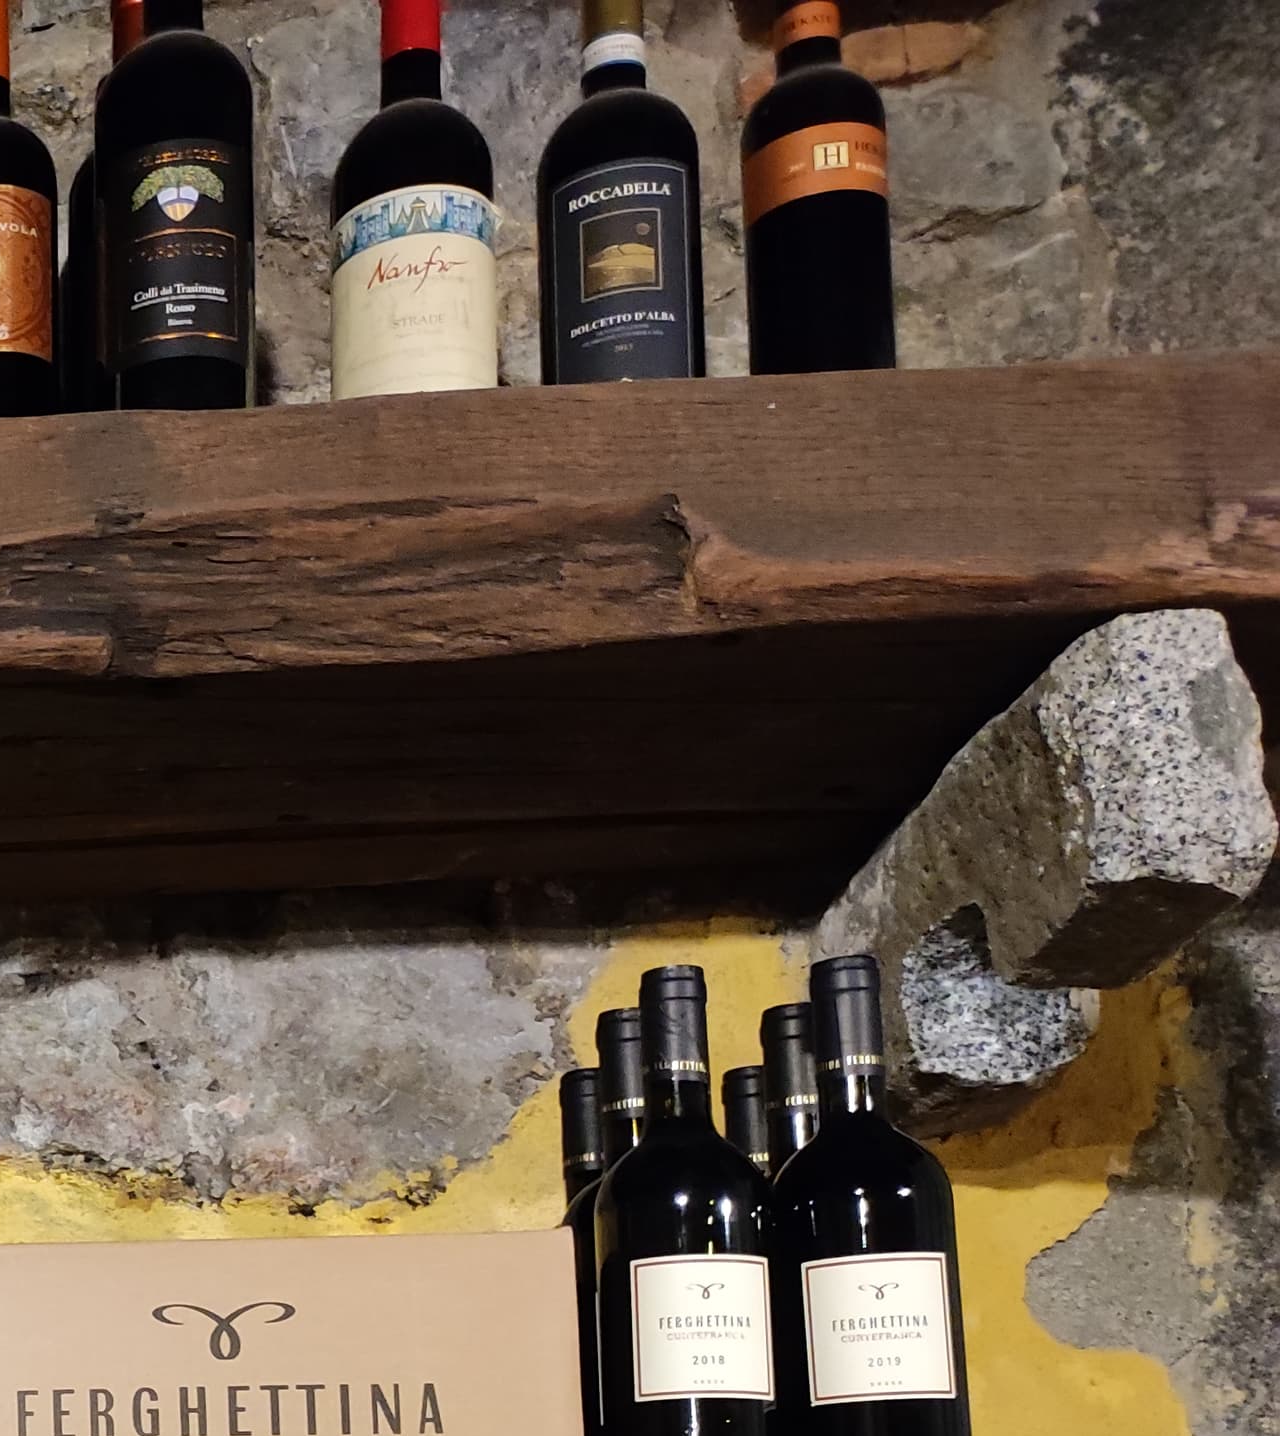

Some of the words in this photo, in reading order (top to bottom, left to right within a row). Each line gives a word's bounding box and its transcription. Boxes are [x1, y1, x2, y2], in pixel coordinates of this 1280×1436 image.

[567, 181, 672, 214] ROCCABELLA
[134, 286, 158, 303] Colli
[174, 283, 225, 296] Trasimeno
[165, 303, 196, 314] Rosso
[570, 313, 632, 339] DOLCETTO
[634, 310, 676, 323] D'ALBA
[658, 1314, 752, 1331] FERGHETTINA
[831, 1314, 929, 1333] FERGHETTINA
[692, 1354, 726, 1366] 2018
[867, 1356, 902, 1368] 2019
